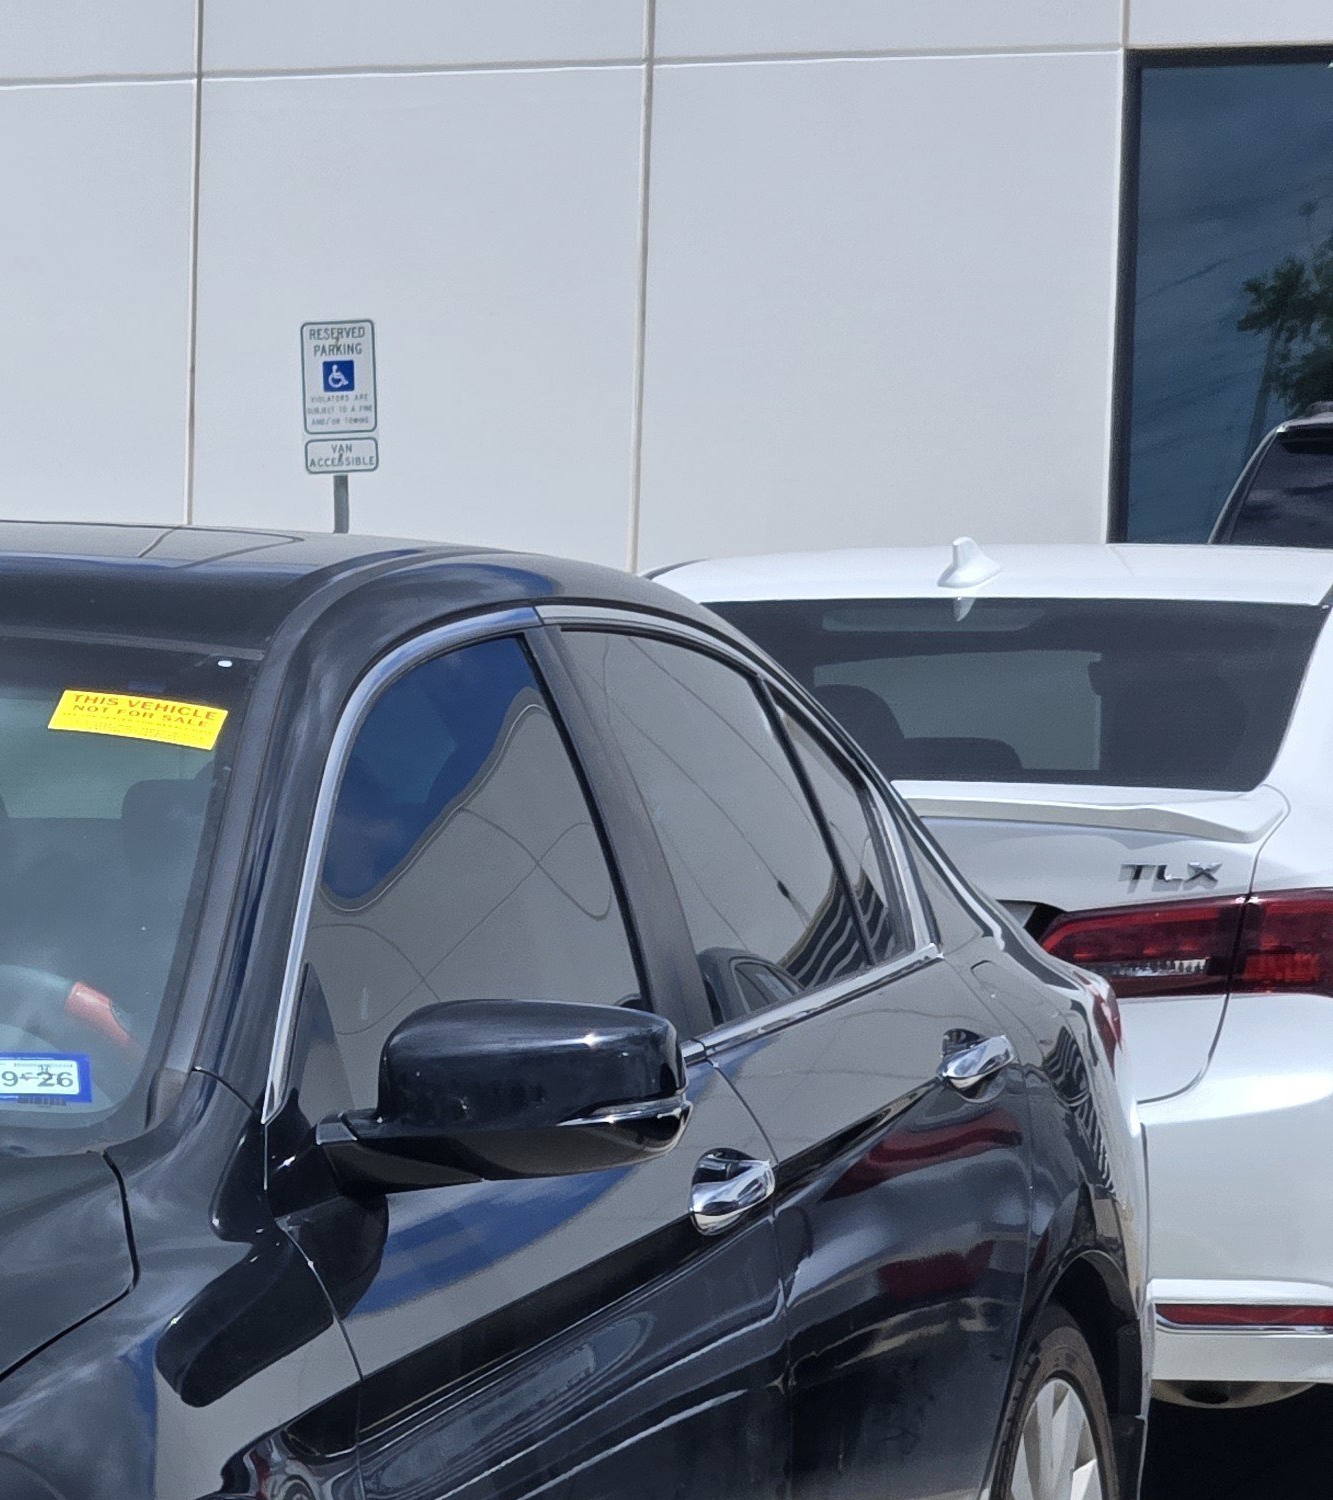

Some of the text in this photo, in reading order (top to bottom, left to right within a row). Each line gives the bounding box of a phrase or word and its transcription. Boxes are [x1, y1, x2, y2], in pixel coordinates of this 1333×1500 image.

[308, 326, 366, 341] RESERVED
[313, 342, 363, 357] PARKING
[331, 444, 353, 454] VAN
[309, 456, 375, 467] ACCESSIBLE
[73, 693, 219, 721] THIS VEHICLE
[71, 704, 209, 728] NOT FOR SALE
[1119, 862, 1223, 885] TLX
